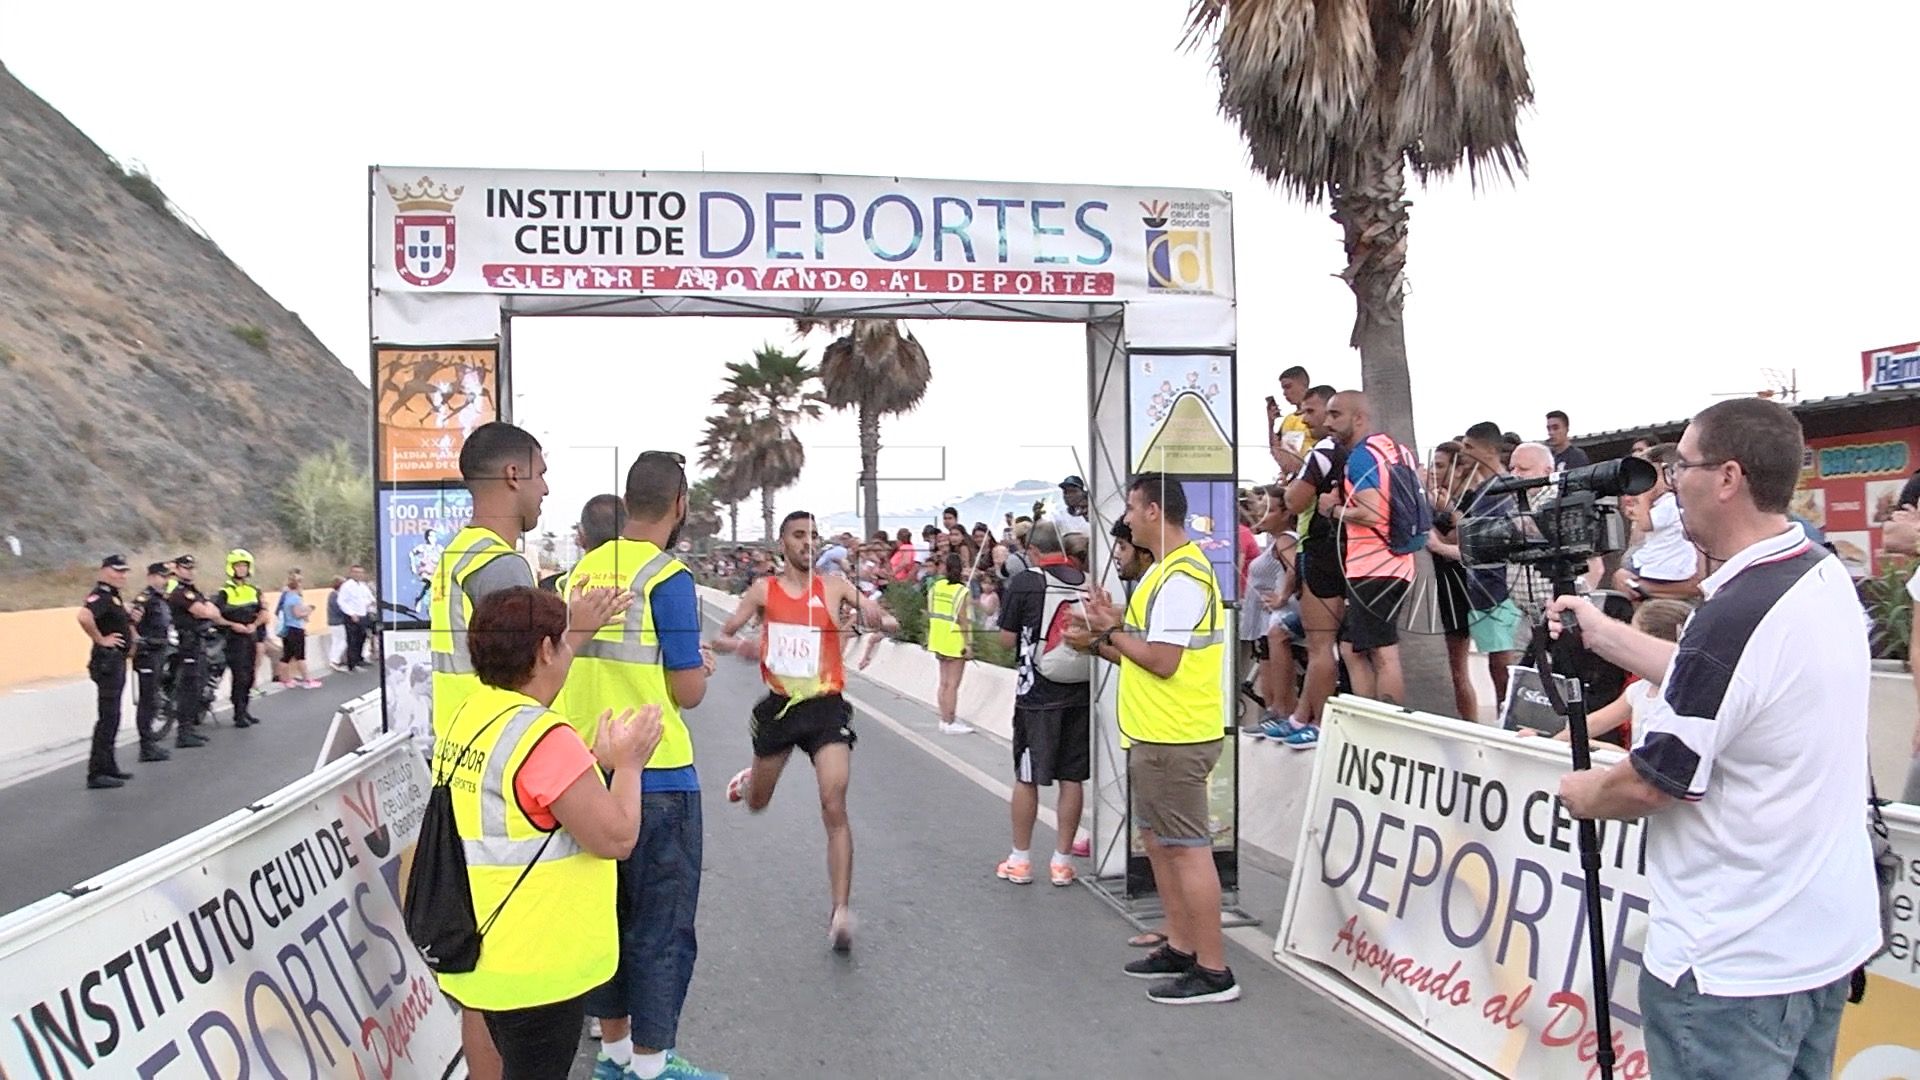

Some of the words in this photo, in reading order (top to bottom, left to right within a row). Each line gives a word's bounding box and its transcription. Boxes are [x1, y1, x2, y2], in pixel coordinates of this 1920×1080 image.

[486, 188, 686, 221] INSTITUTO
[699, 191, 1112, 266] DEPORTES
[514, 224, 623, 255] CEUTI
[636, 226, 684, 256] DE
[501, 266, 656, 289] SIEMPRE
[676, 267, 869, 291] APOYANDO
[888, 272, 928, 291] AL
[947, 272, 1096, 293] DEPORTE
[387, 504, 418, 519] 100
[1336, 742, 1508, 832] INSTITUTO
[12, 888, 254, 1080] INSTITUTO
[249, 827, 328, 928] CEUTI
[320, 818, 360, 881] DE
[1332, 914, 1470, 1007] Apoyando
[1483, 984, 1534, 1030] al
